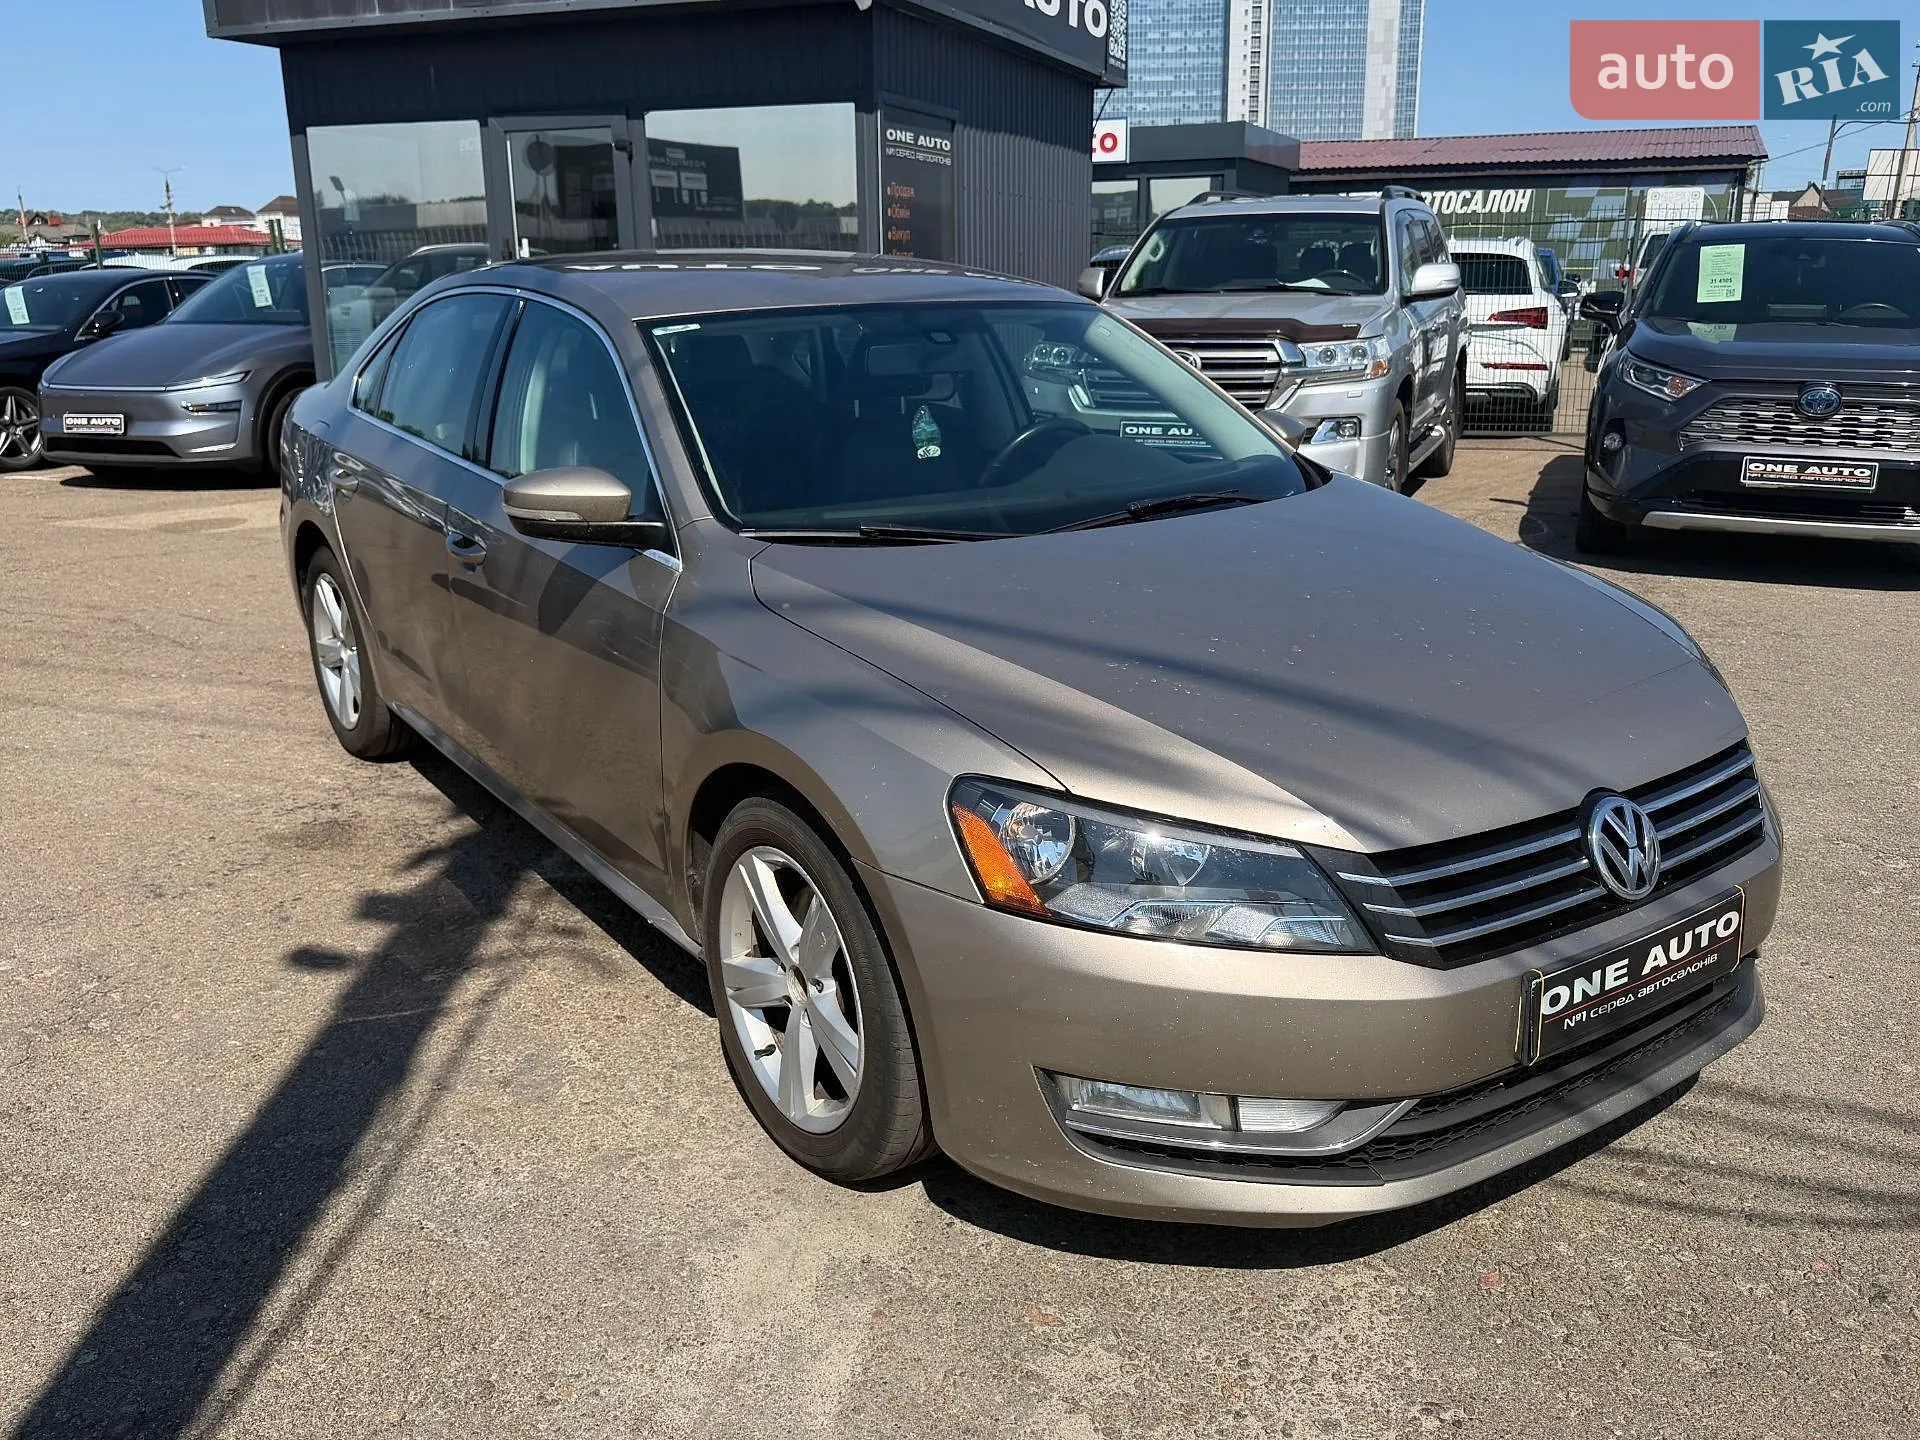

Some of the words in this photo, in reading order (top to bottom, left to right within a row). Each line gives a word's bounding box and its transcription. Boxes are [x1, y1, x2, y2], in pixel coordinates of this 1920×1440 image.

[1024, 0, 1107, 38] TO
[886, 129, 914, 144] ONE
[917, 135, 951, 151] AUTO
[1092, 131, 1118, 154] O
[66, 417, 88, 425] ONE
[90, 417, 121, 425] AUTO
[1125, 426, 1163, 435] ONE
[1748, 462, 1799, 473] ONE
[1804, 465, 1871, 477] AUTO
[1542, 958, 1629, 1016] ONE
[1641, 910, 1740, 976] AUTO
